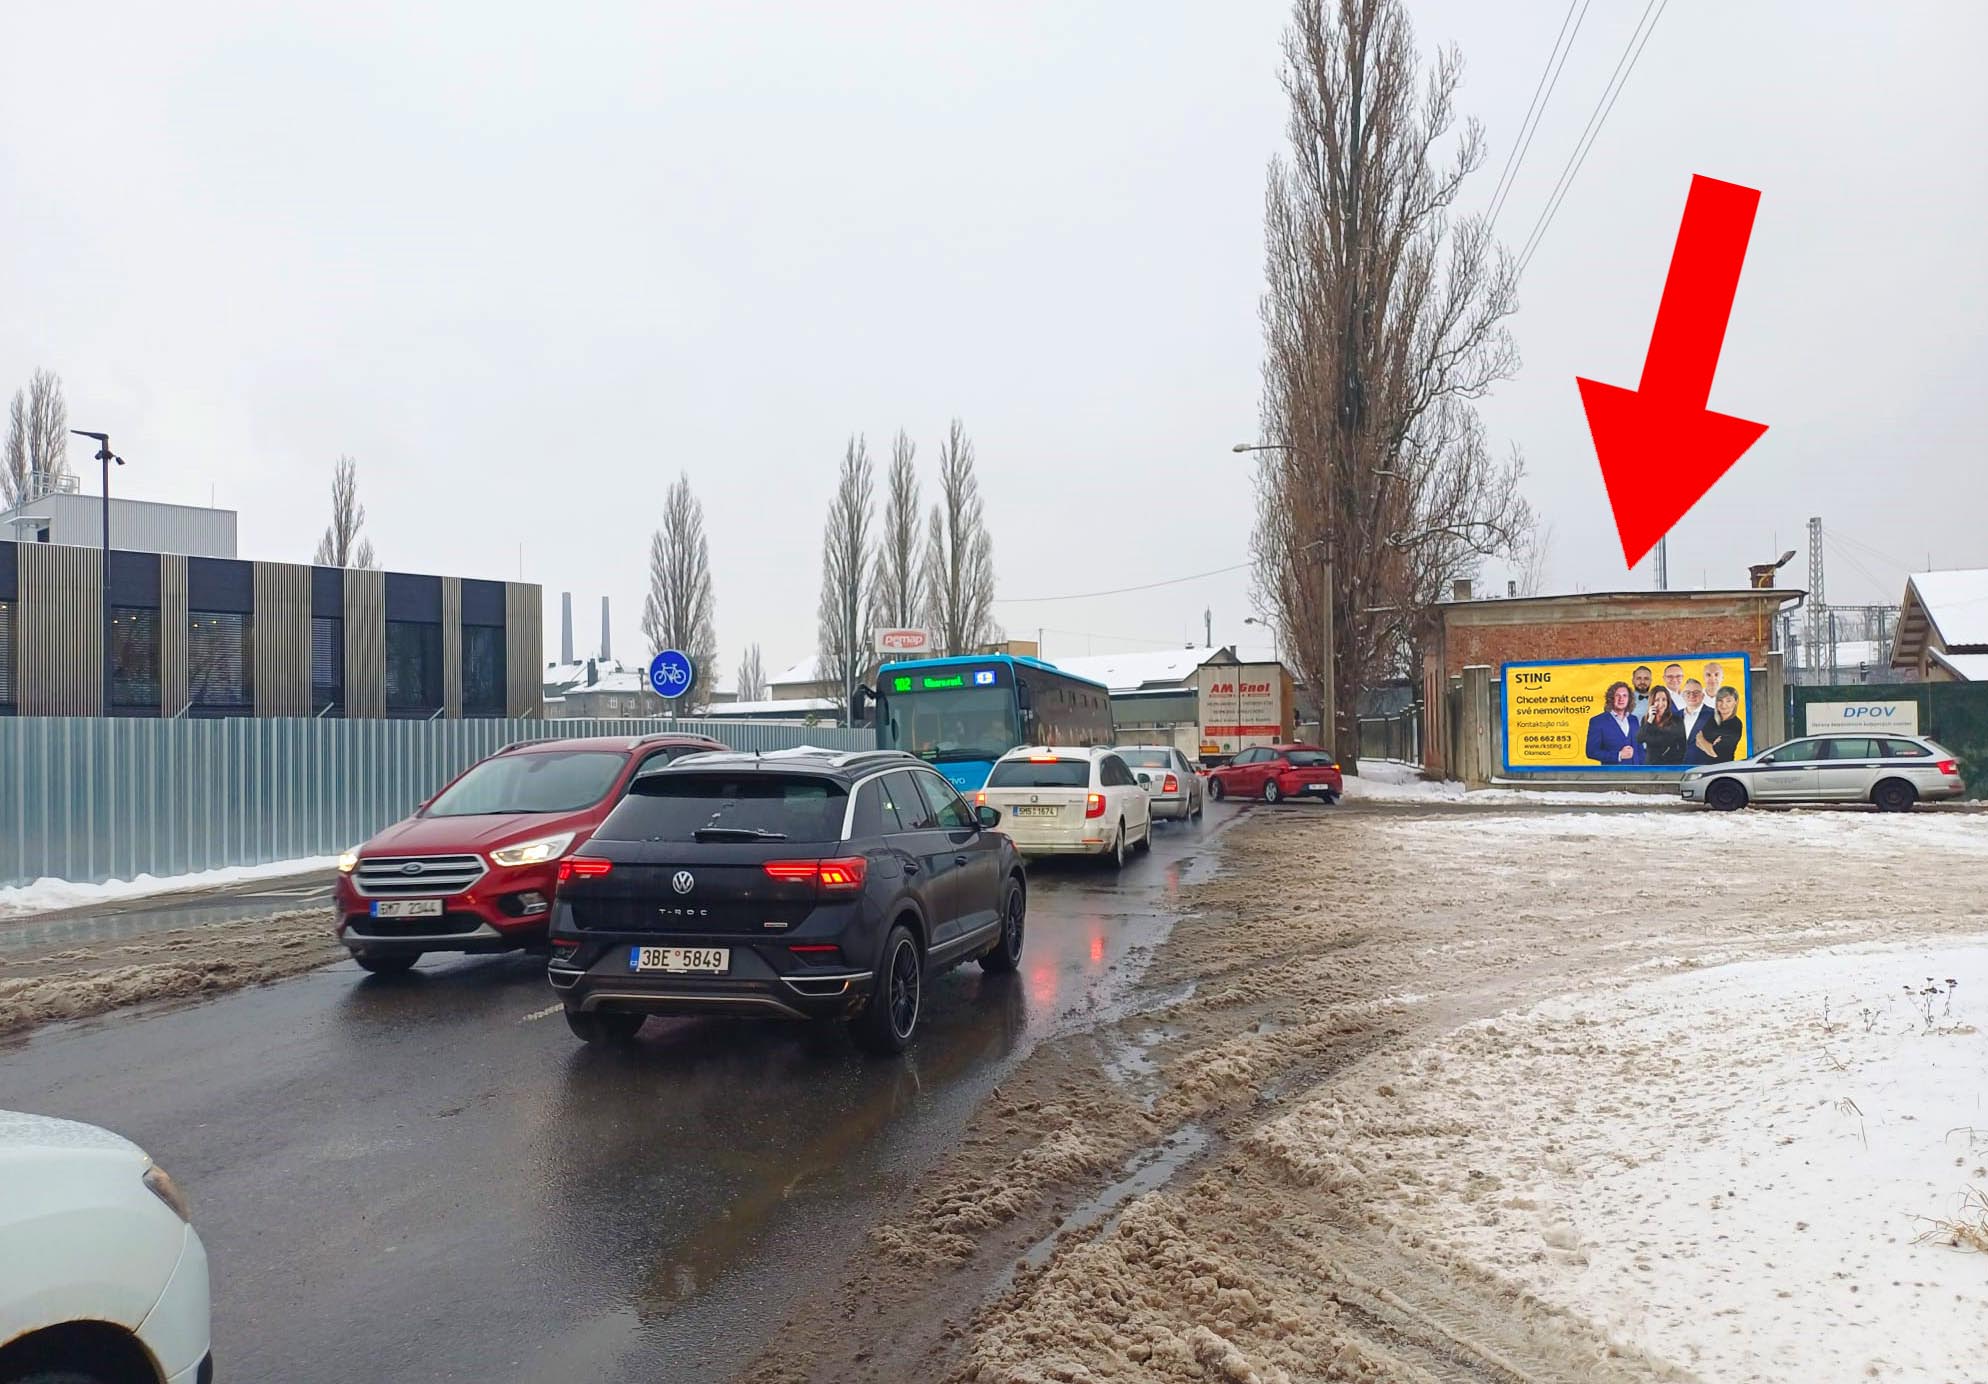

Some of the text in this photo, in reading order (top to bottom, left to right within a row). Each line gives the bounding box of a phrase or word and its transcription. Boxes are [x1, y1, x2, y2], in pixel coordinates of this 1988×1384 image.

[1515, 673, 1551, 684] STING
[1210, 683, 1233, 693] AM
[1516, 694, 1594, 704] Chcete znát cenu
[1516, 706, 1532, 715] své
[1843, 706, 1896, 718] DPOV
[642, 950, 722, 968] 3BE 5849
